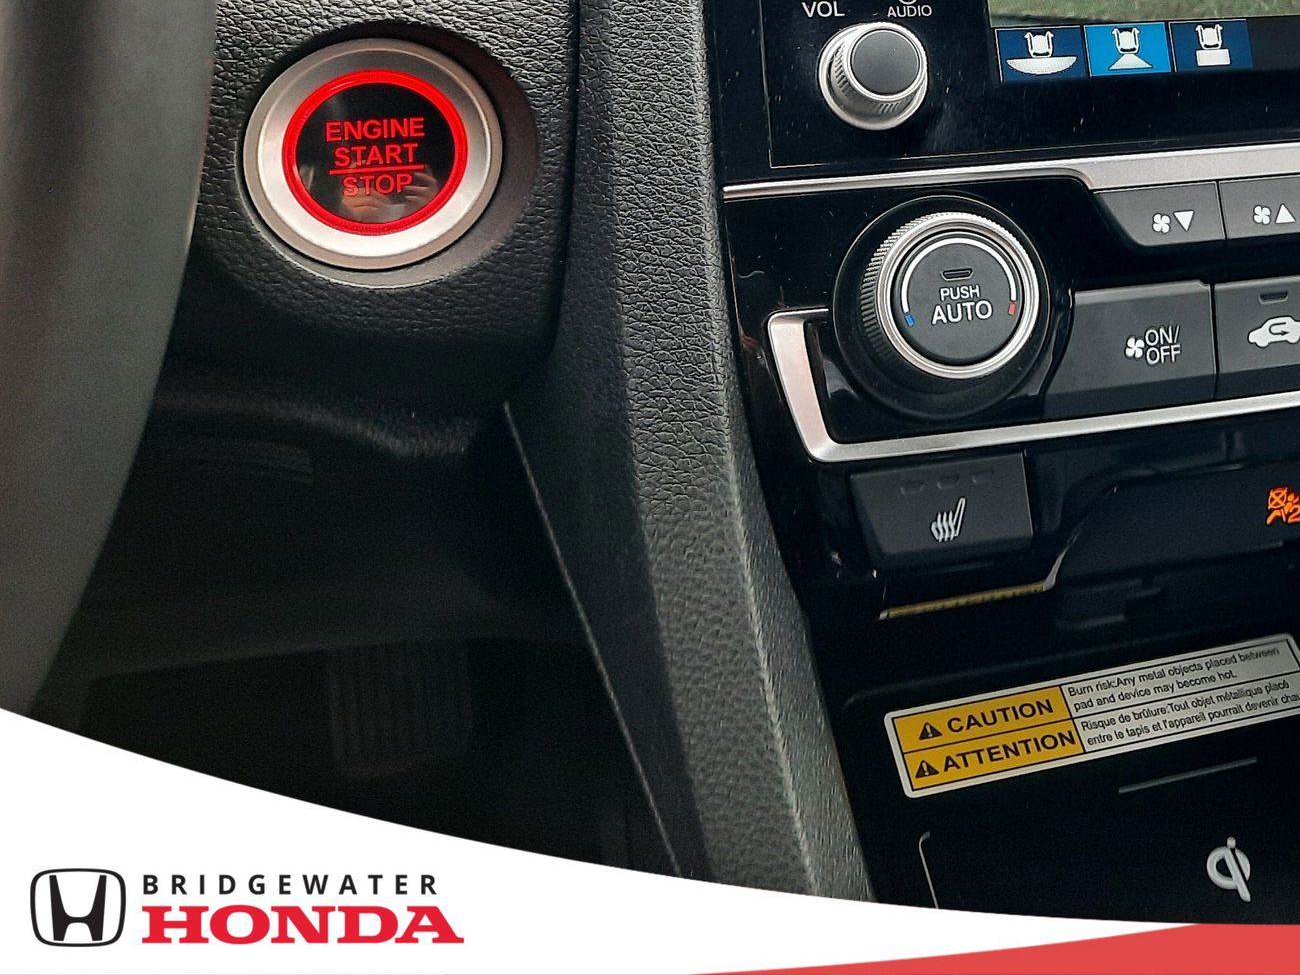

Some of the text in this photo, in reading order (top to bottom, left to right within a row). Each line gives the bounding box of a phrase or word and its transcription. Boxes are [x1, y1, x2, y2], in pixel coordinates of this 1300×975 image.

[802, 1, 845, 18] VOL
[887, 4, 933, 18] AUDIO
[324, 117, 425, 142] ENGINE
[334, 142, 419, 167] START
[342, 174, 413, 197] STOP
[940, 285, 980, 302] PUSH
[931, 300, 994, 325] AUTO
[1145, 324, 1181, 346] ON/
[1146, 344, 1181, 365] OFF
[1068, 685, 1094, 697] Burn
[1138, 668, 1166, 683] metal
[1168, 662, 1203, 677] objects
[1205, 654, 1238, 671] placed
[1238, 647, 1280, 662] between
[1073, 698, 1094, 713] pad
[1096, 693, 1116, 706] and
[1118, 687, 1151, 702] device
[1153, 682, 1175, 694] may
[1176, 673, 1216, 690] become
[1080, 717, 1117, 731] Risque
[1118, 712, 1131, 724] de
[1191, 694, 1216, 709] objet
[1264, 679, 1290, 694] placé
[947, 698, 1054, 733] CAUTION
[1087, 732, 1113, 746] entre
[1114, 729, 1125, 740] le
[1125, 724, 1151, 738] tapis
[1152, 721, 1163, 732] et
[1162, 712, 1206, 730] l'appareil
[1207, 705, 1245, 722] pourrait
[1245, 697, 1279, 712] devenir
[943, 730, 1076, 772] ATTENTION
